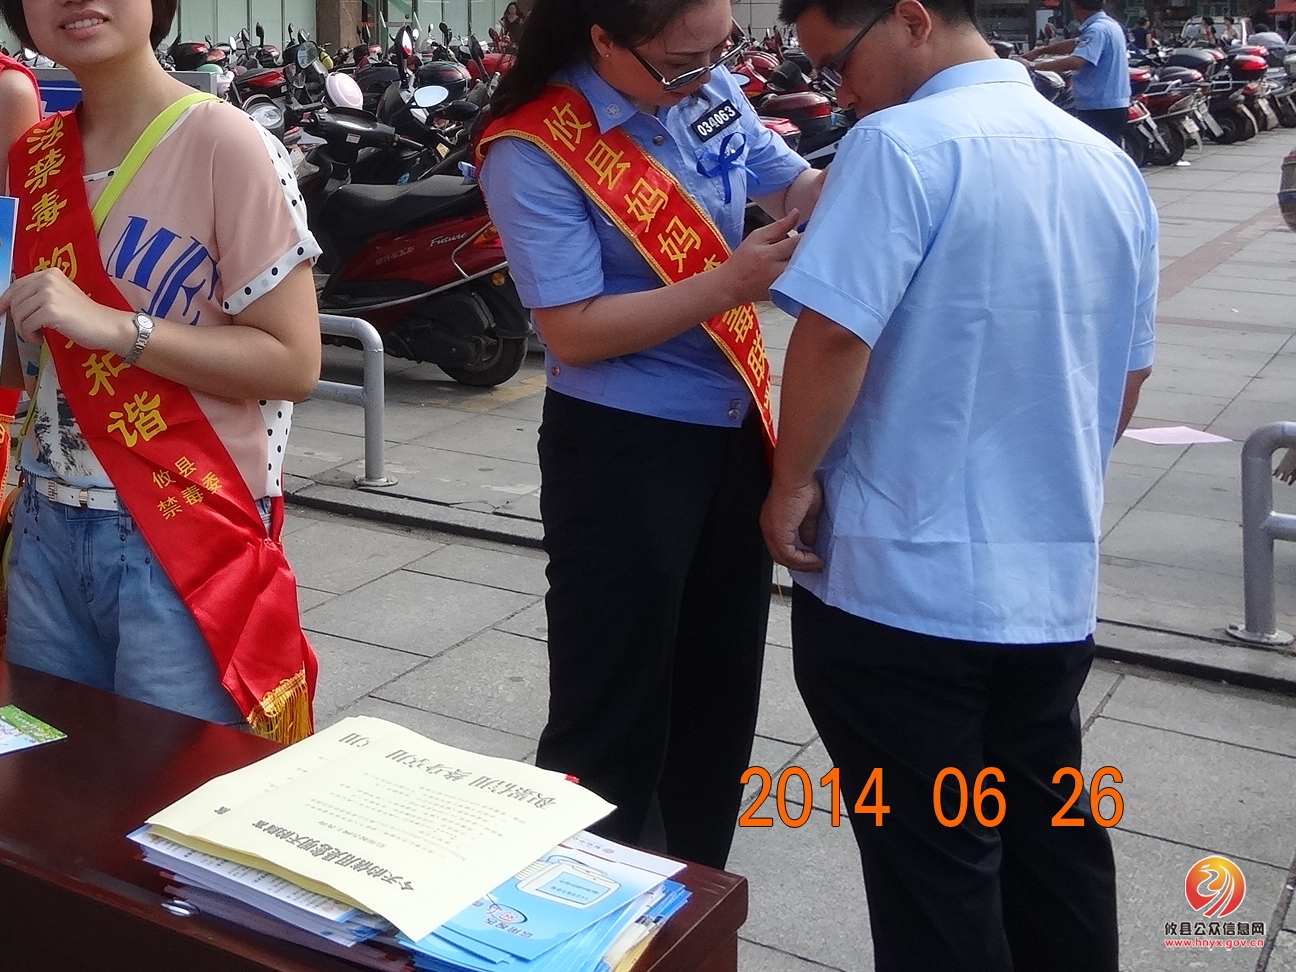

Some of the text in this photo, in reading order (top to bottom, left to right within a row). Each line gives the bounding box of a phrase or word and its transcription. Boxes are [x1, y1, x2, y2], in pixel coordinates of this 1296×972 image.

[695, 105, 737, 138] 034063
[429, 232, 469, 247] Future
[151, 455, 198, 489] 攸县
[156, 470, 224, 521] 禁毒委
[251, 819, 414, 894] 今天的信用是您明天的财富
